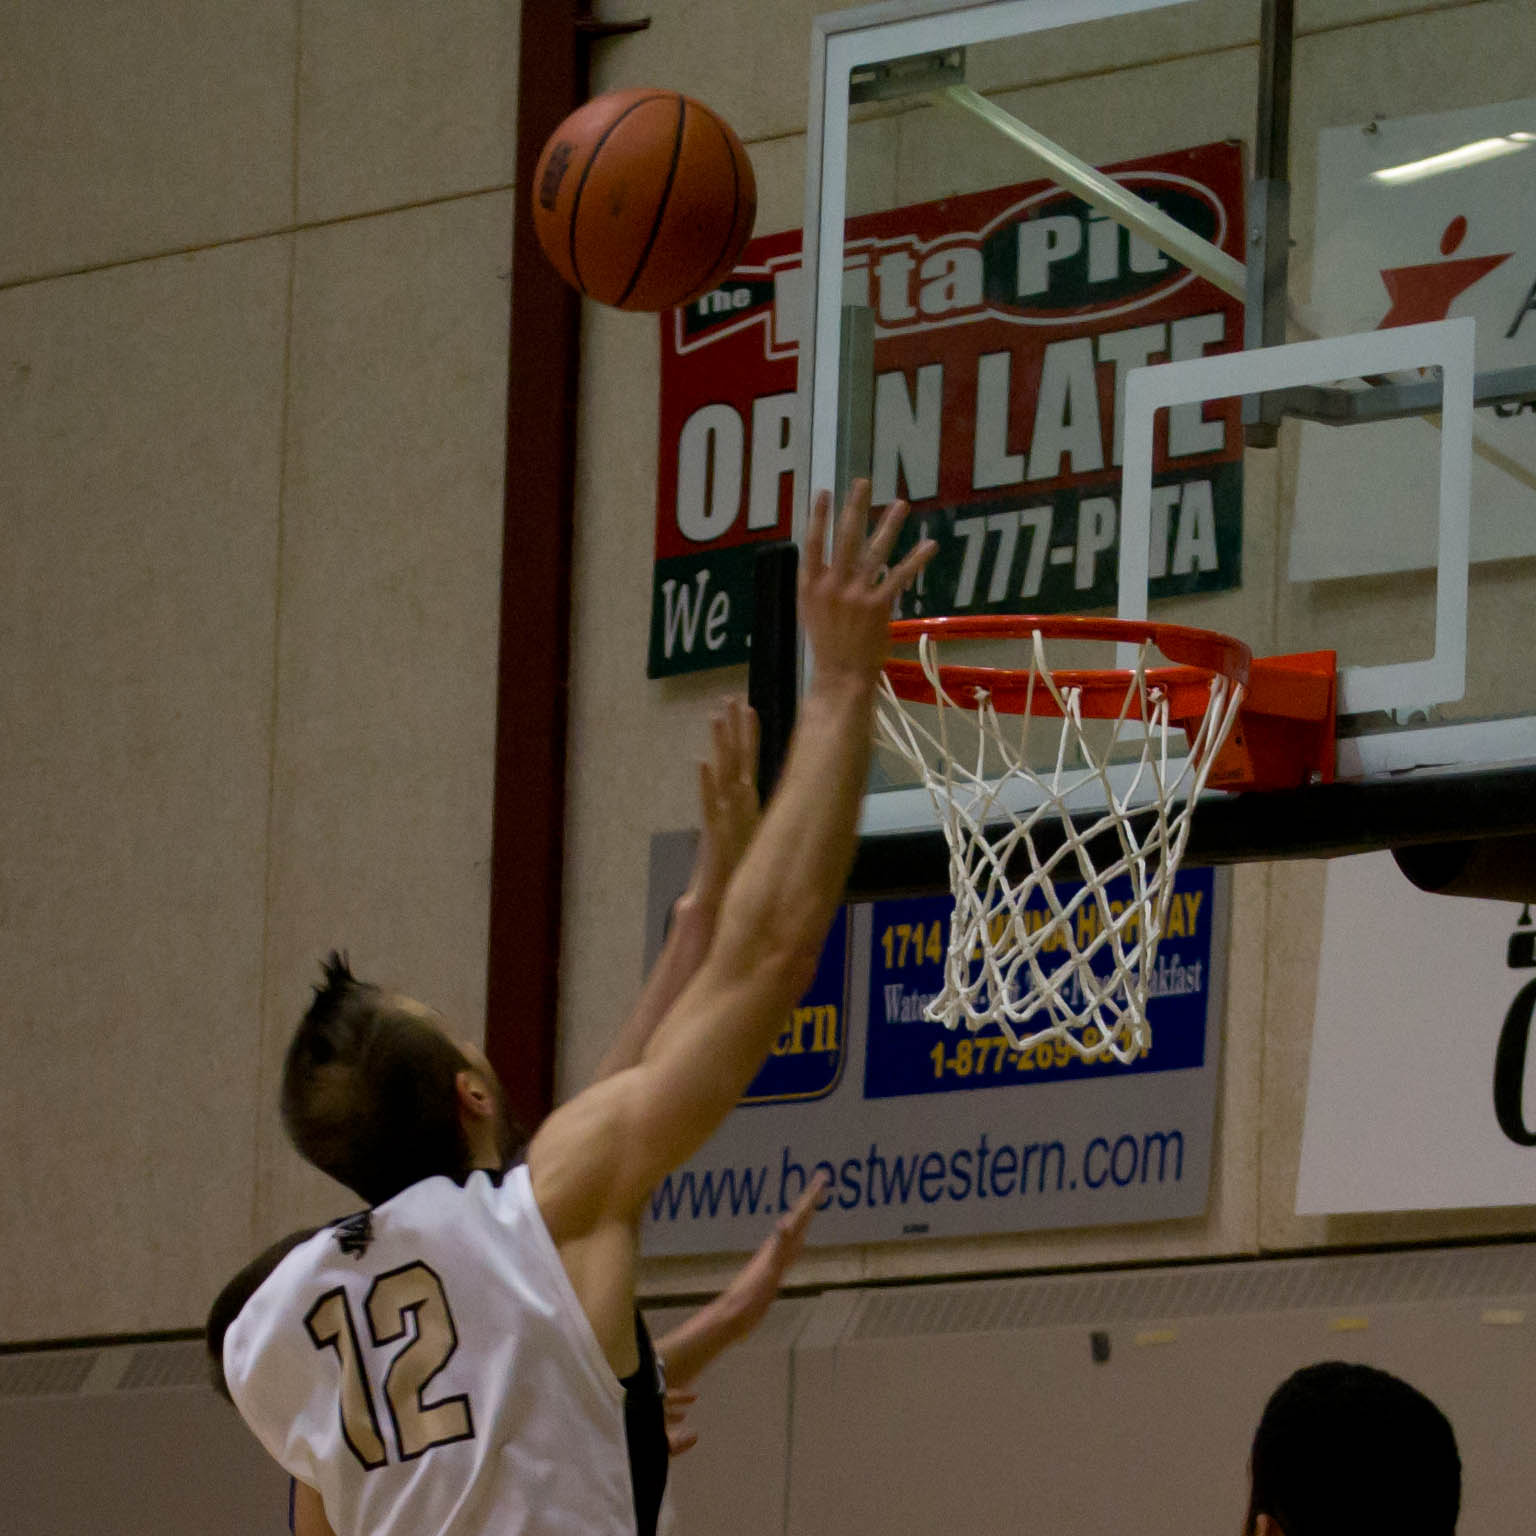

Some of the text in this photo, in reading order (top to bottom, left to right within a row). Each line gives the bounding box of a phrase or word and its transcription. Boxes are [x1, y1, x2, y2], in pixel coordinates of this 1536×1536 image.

[674, 312, 1226, 543] OPN LATE
[952, 479, 1221, 612] 777-PTA
[660, 567, 731, 660] We
[880, 918, 942, 969] 1714
[303, 1260, 475, 1472] 12
